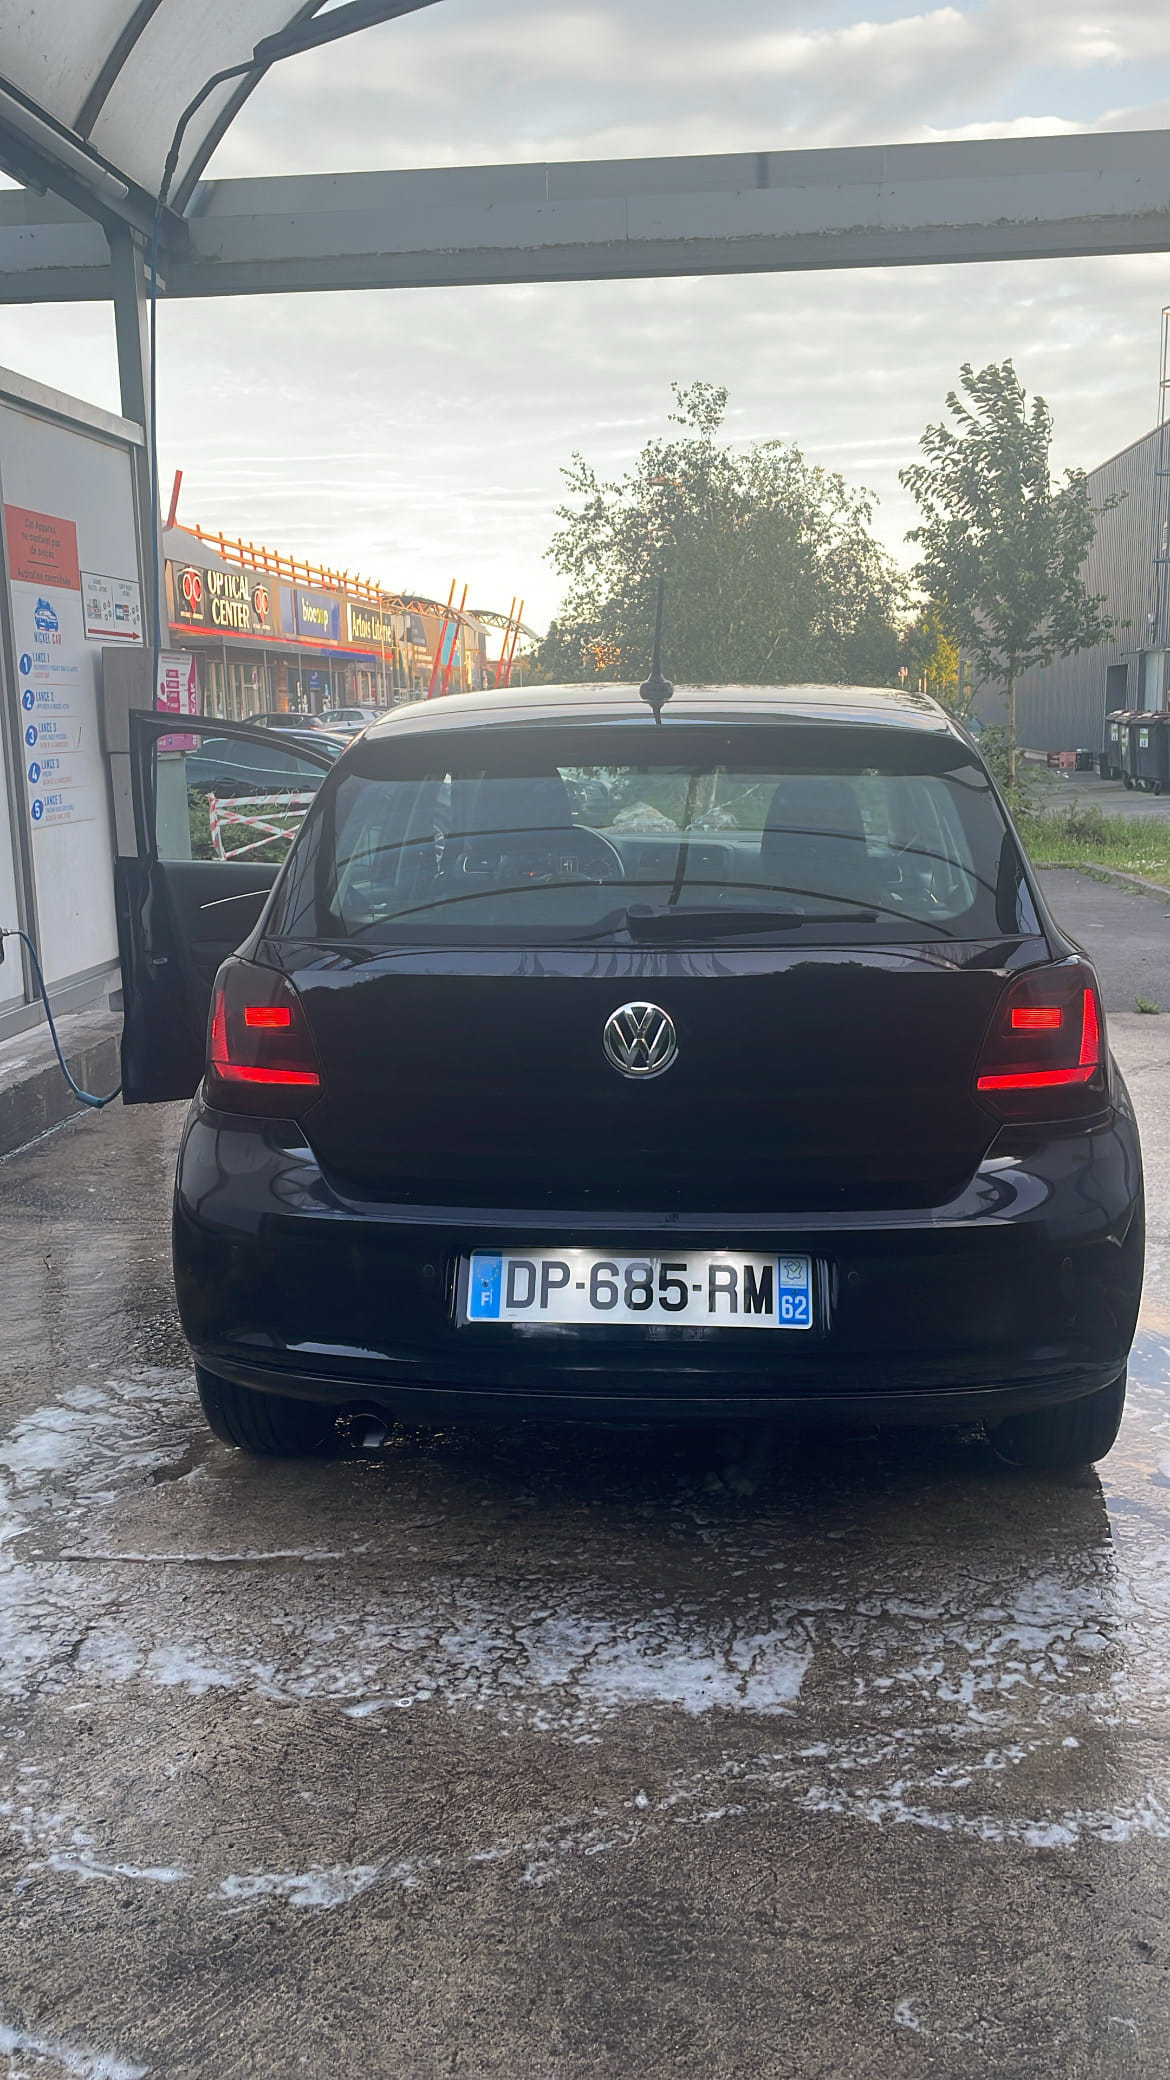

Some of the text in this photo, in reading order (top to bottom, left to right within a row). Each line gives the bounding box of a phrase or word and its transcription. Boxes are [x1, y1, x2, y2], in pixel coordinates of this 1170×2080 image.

[207, 570, 251, 600] OPTICAL
[212, 598, 249, 628] CENTER
[352, 611, 371, 639] Artois
[481, 1292, 490, 1306] F
[505, 1260, 774, 1315] DP-685-RM
[781, 1295, 807, 1319] 62
